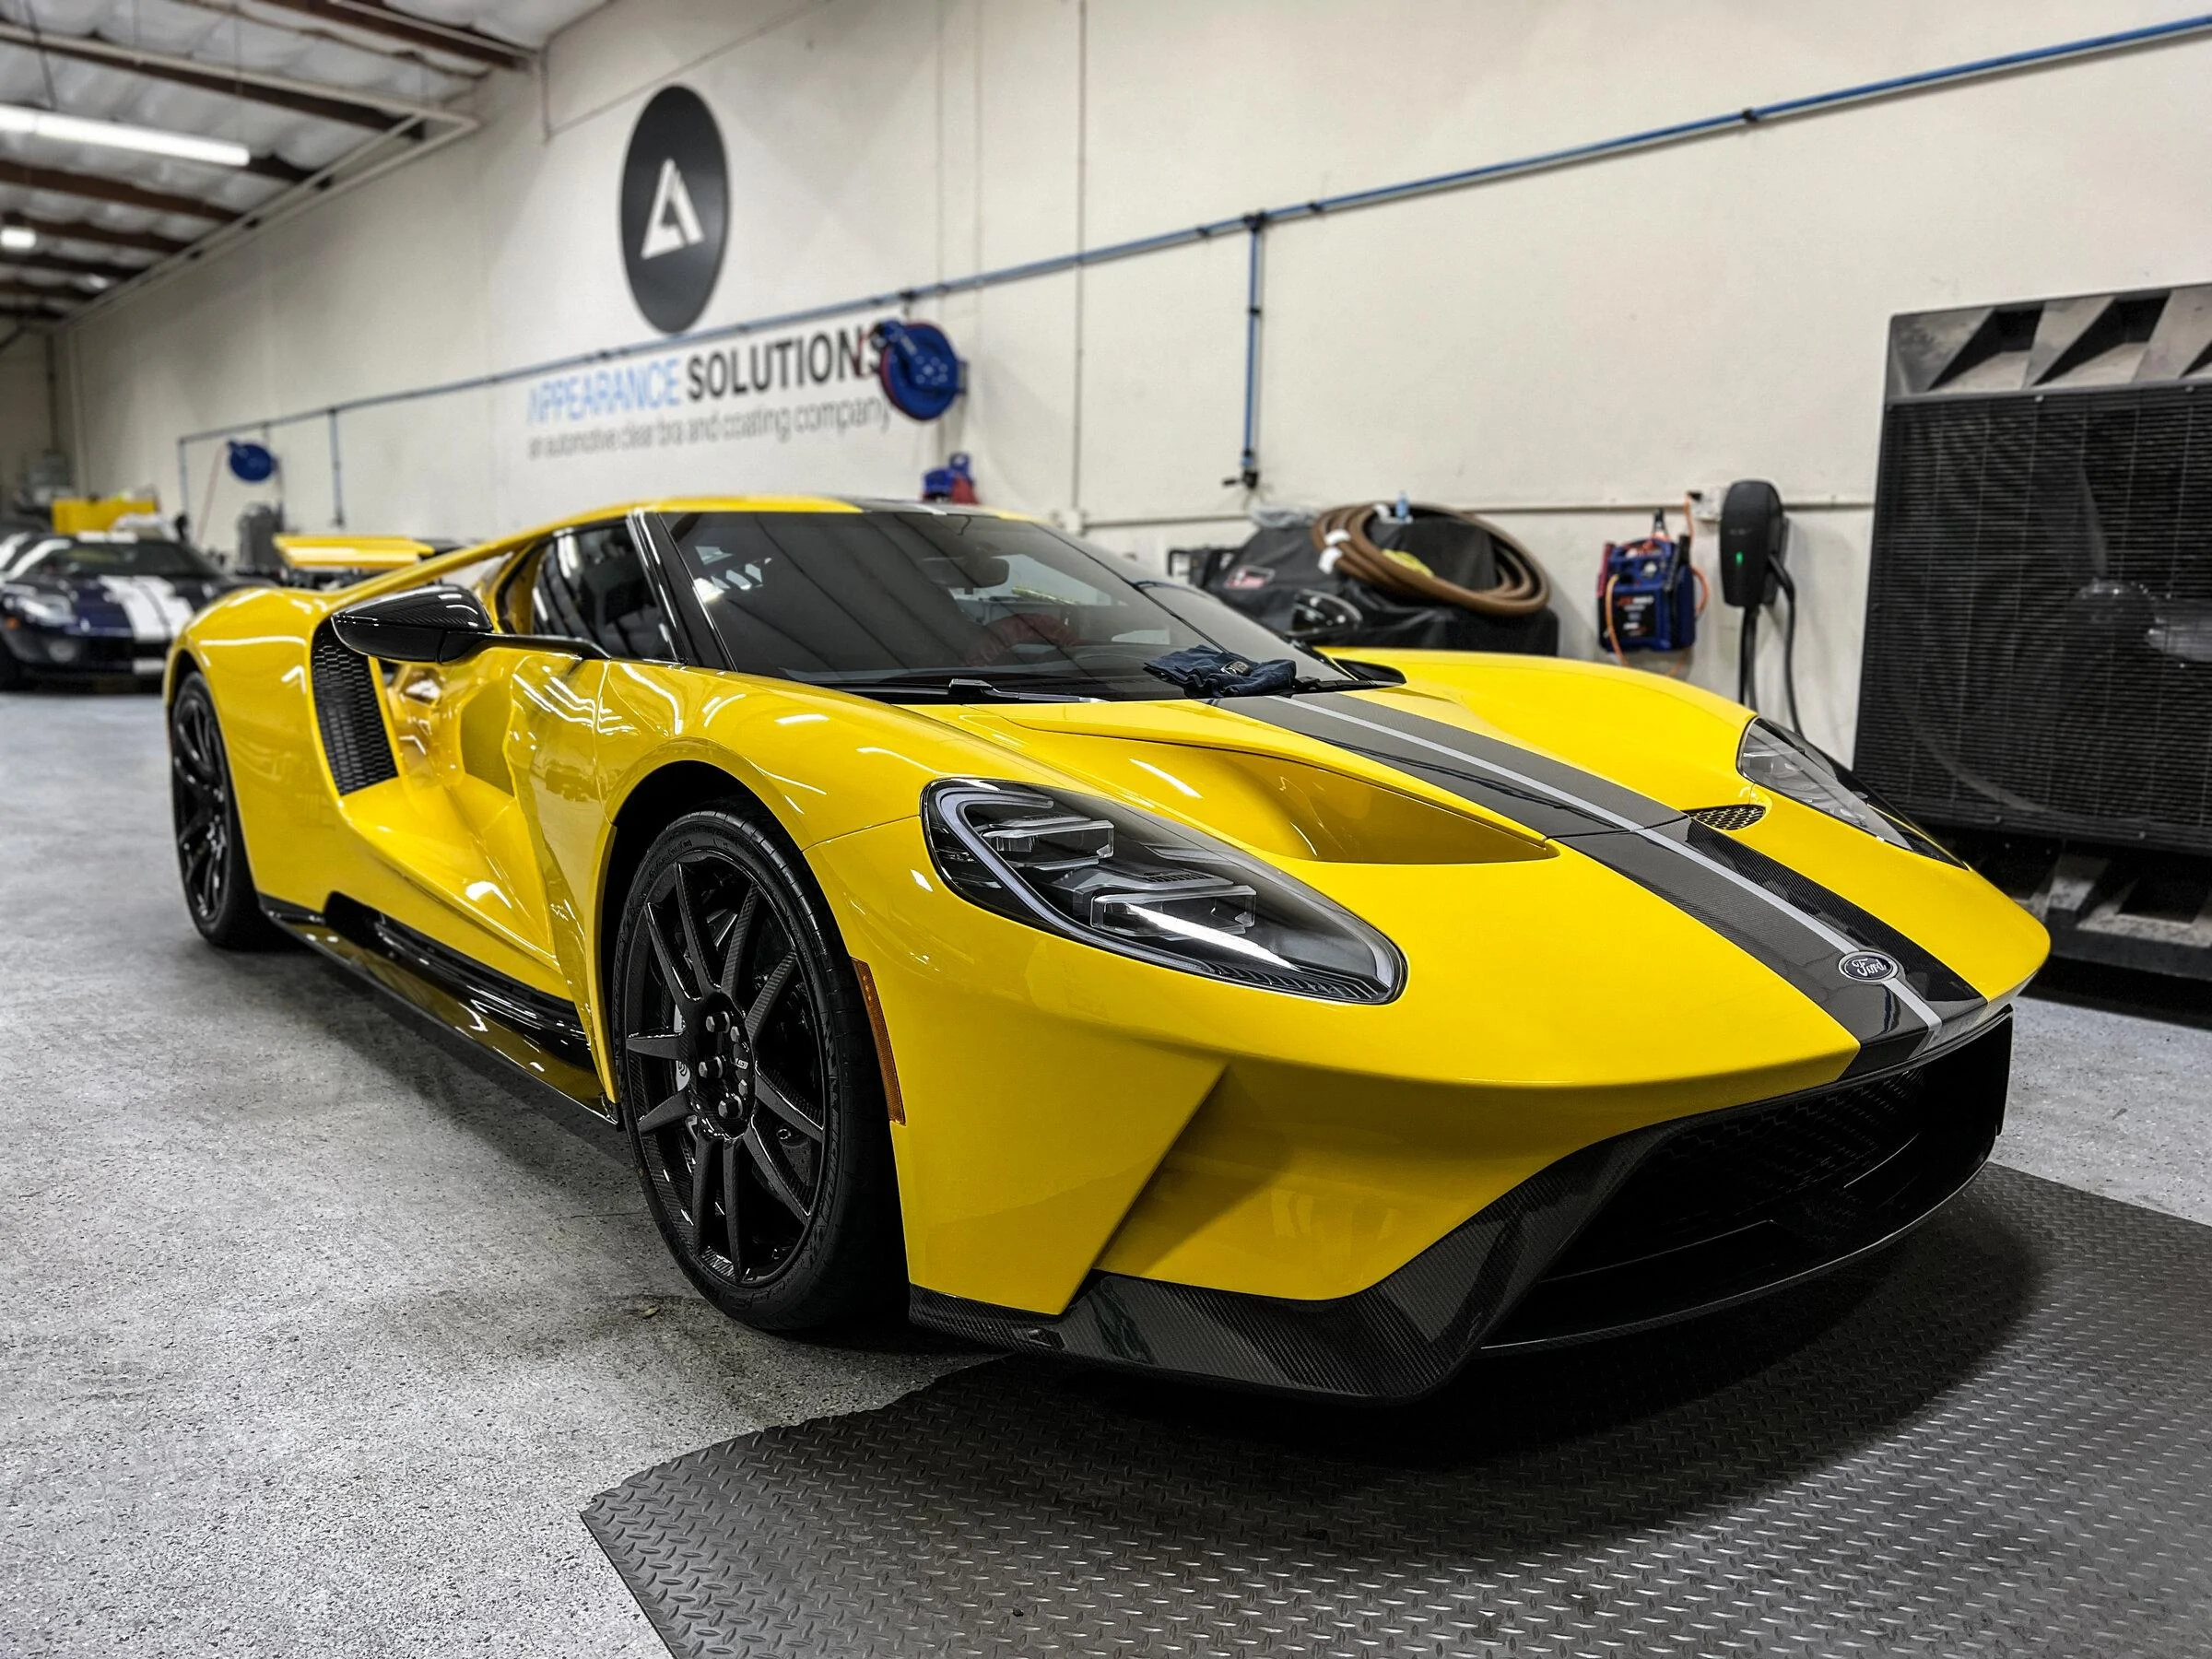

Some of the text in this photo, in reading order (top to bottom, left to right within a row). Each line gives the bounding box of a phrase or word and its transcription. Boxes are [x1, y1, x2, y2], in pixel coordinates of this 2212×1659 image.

[528, 359, 682, 425] APPEARANCE
[688, 410, 721, 443] and
[724, 405, 792, 443] coating
[794, 395, 891, 436] company
[1851, 958, 1888, 977] Ford
